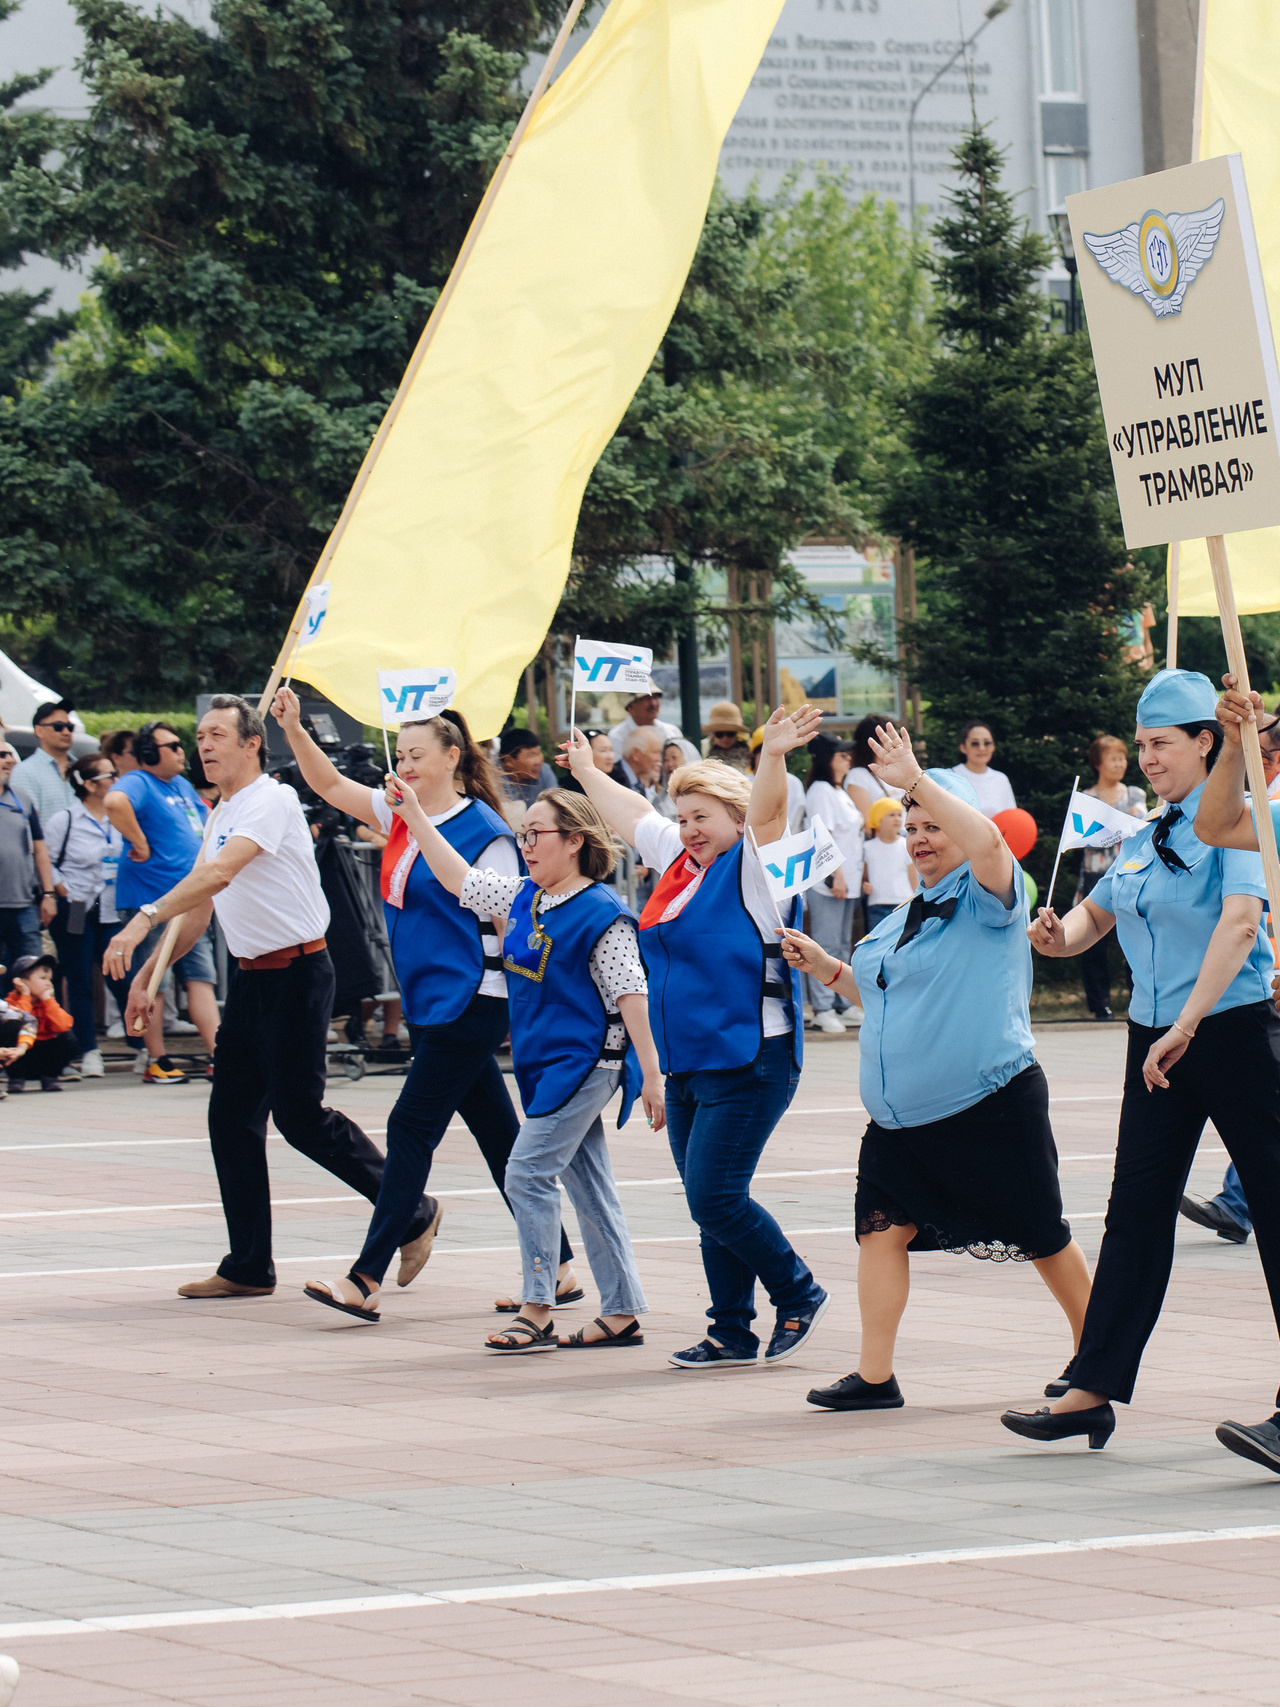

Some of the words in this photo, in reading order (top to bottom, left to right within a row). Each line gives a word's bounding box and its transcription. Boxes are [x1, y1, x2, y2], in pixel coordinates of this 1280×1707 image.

[1154, 358, 1204, 399] МУП
[1112, 399, 1268, 458] «УПРАВЛЕНИЕ
[1139, 458, 1254, 507] ТРАМВАЯ»
[575, 657, 631, 681] УТ
[381, 685, 437, 713] УТ
